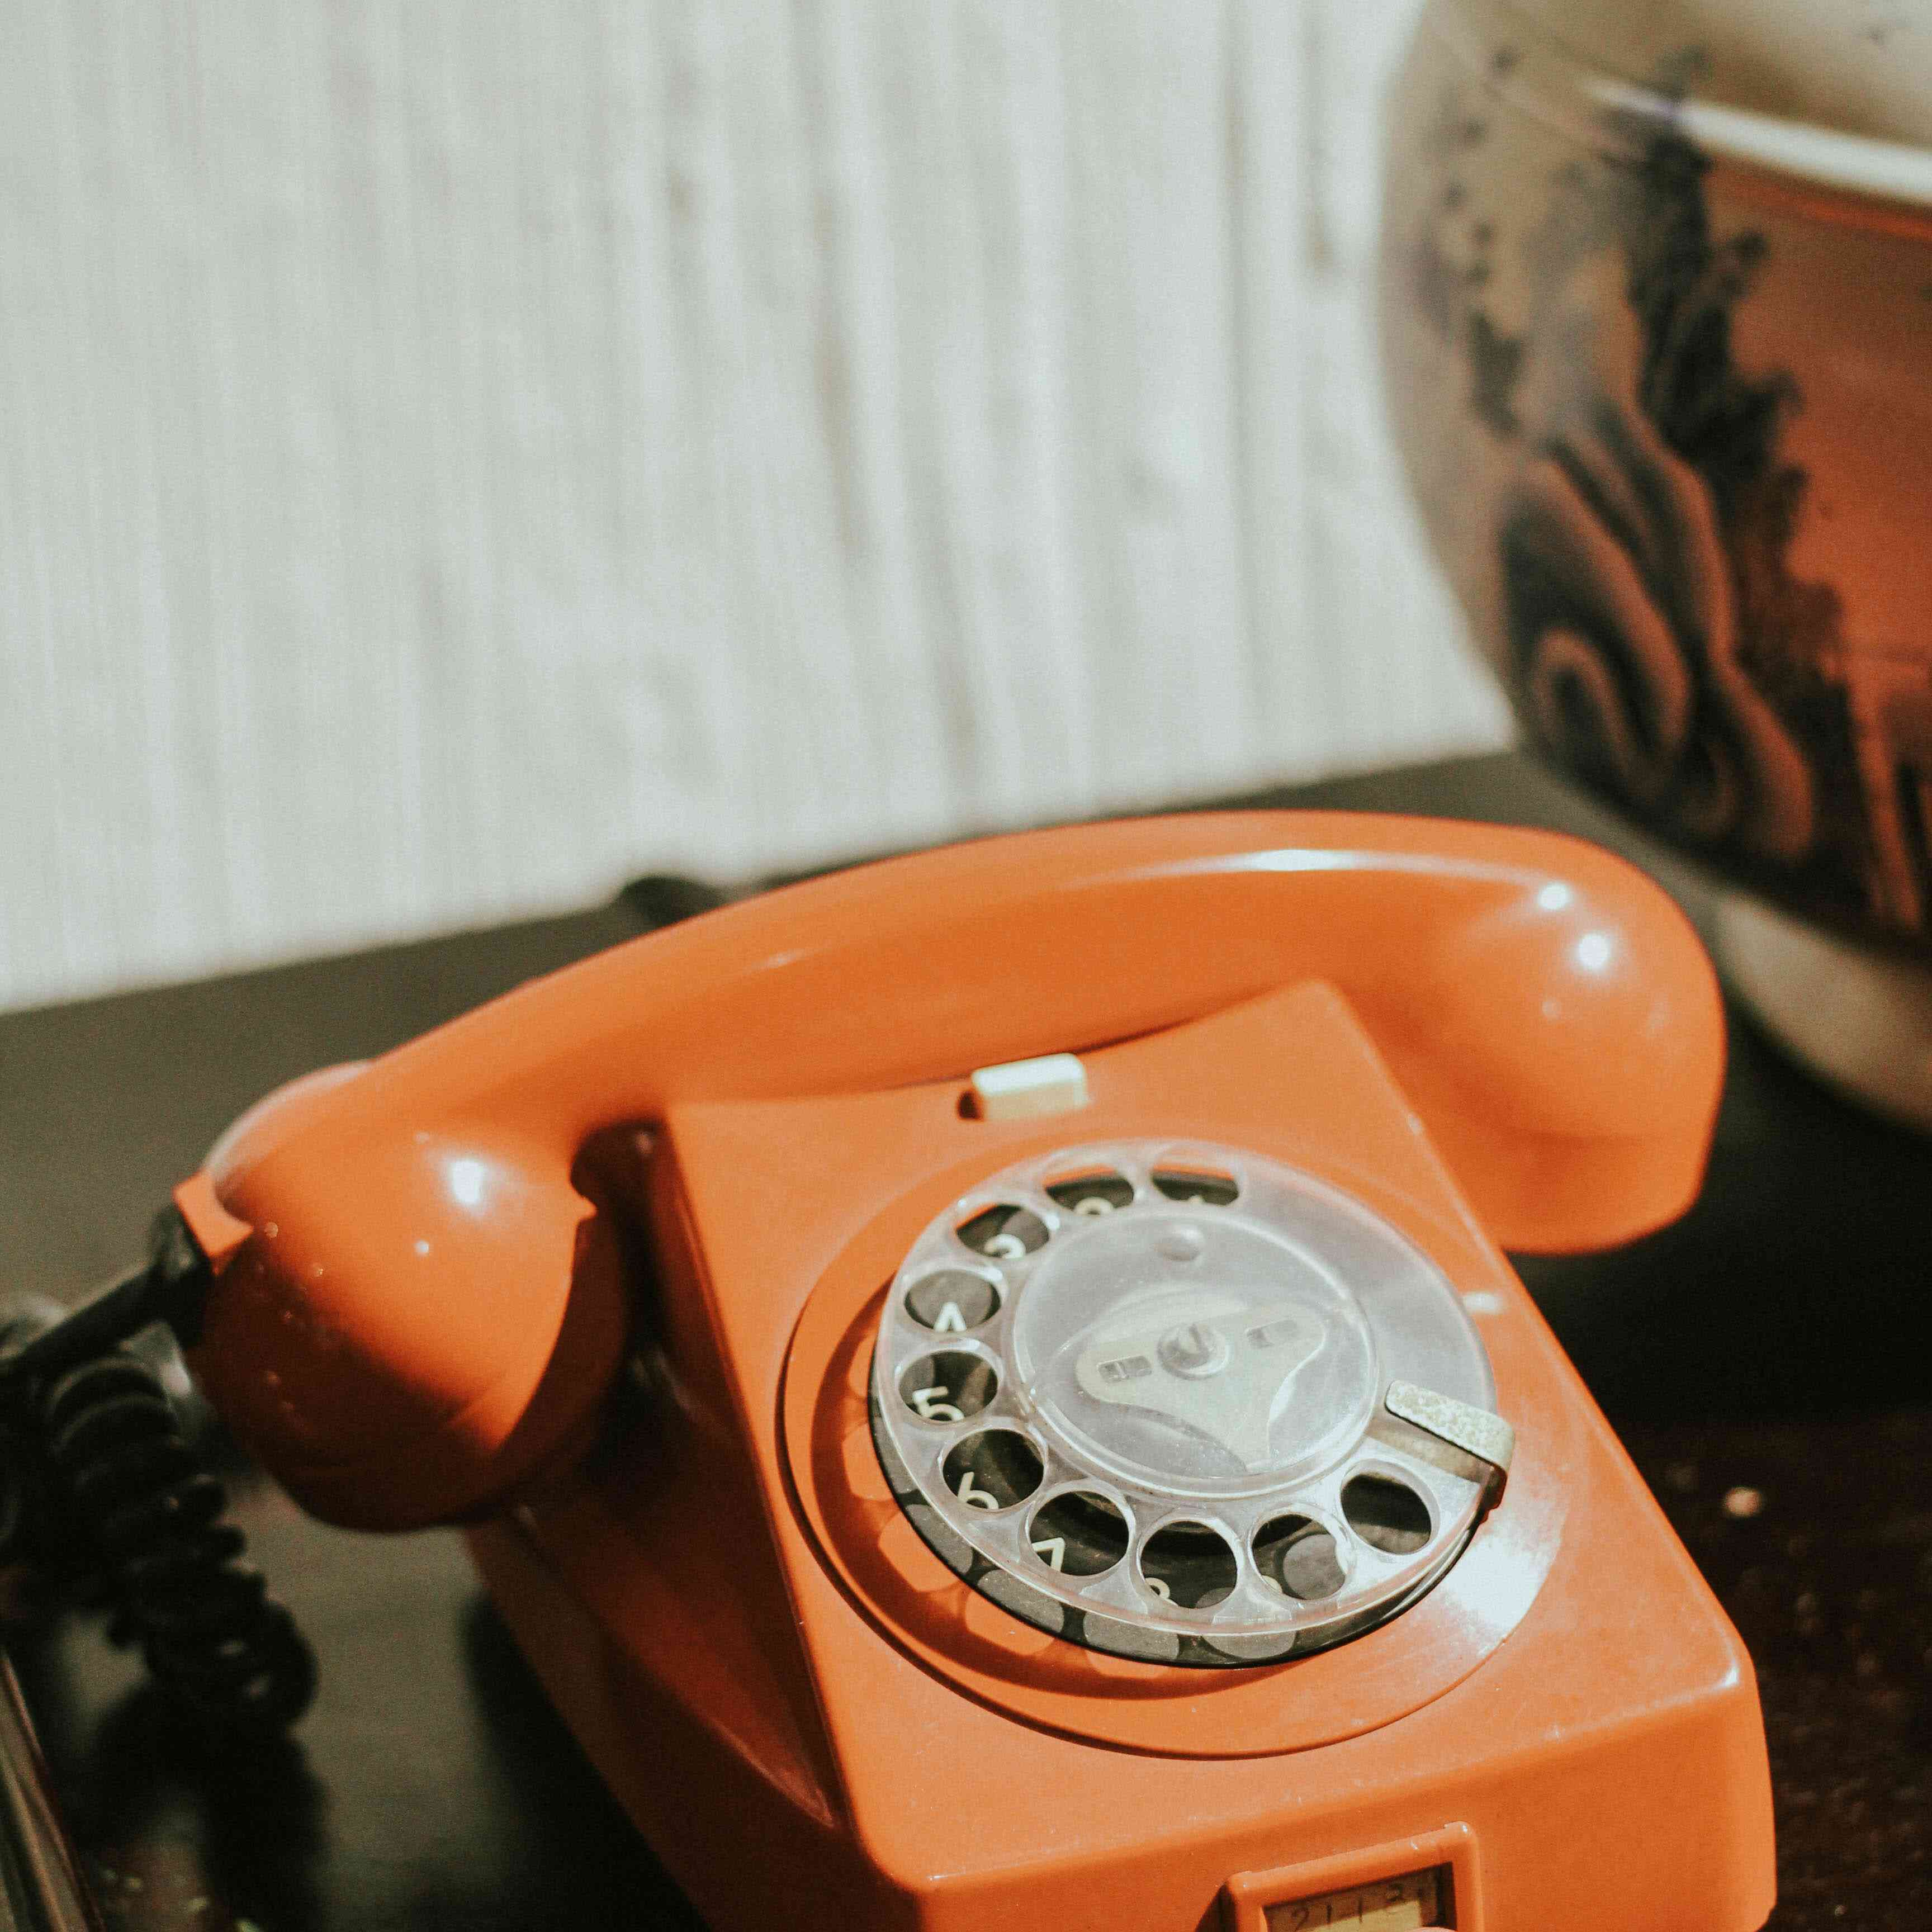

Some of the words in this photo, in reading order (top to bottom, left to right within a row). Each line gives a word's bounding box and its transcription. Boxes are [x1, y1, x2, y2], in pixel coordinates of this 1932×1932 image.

[912, 1385, 965, 1423] 5
[956, 1471, 1000, 1510] 6
[1031, 1537, 1066, 1573] 7
